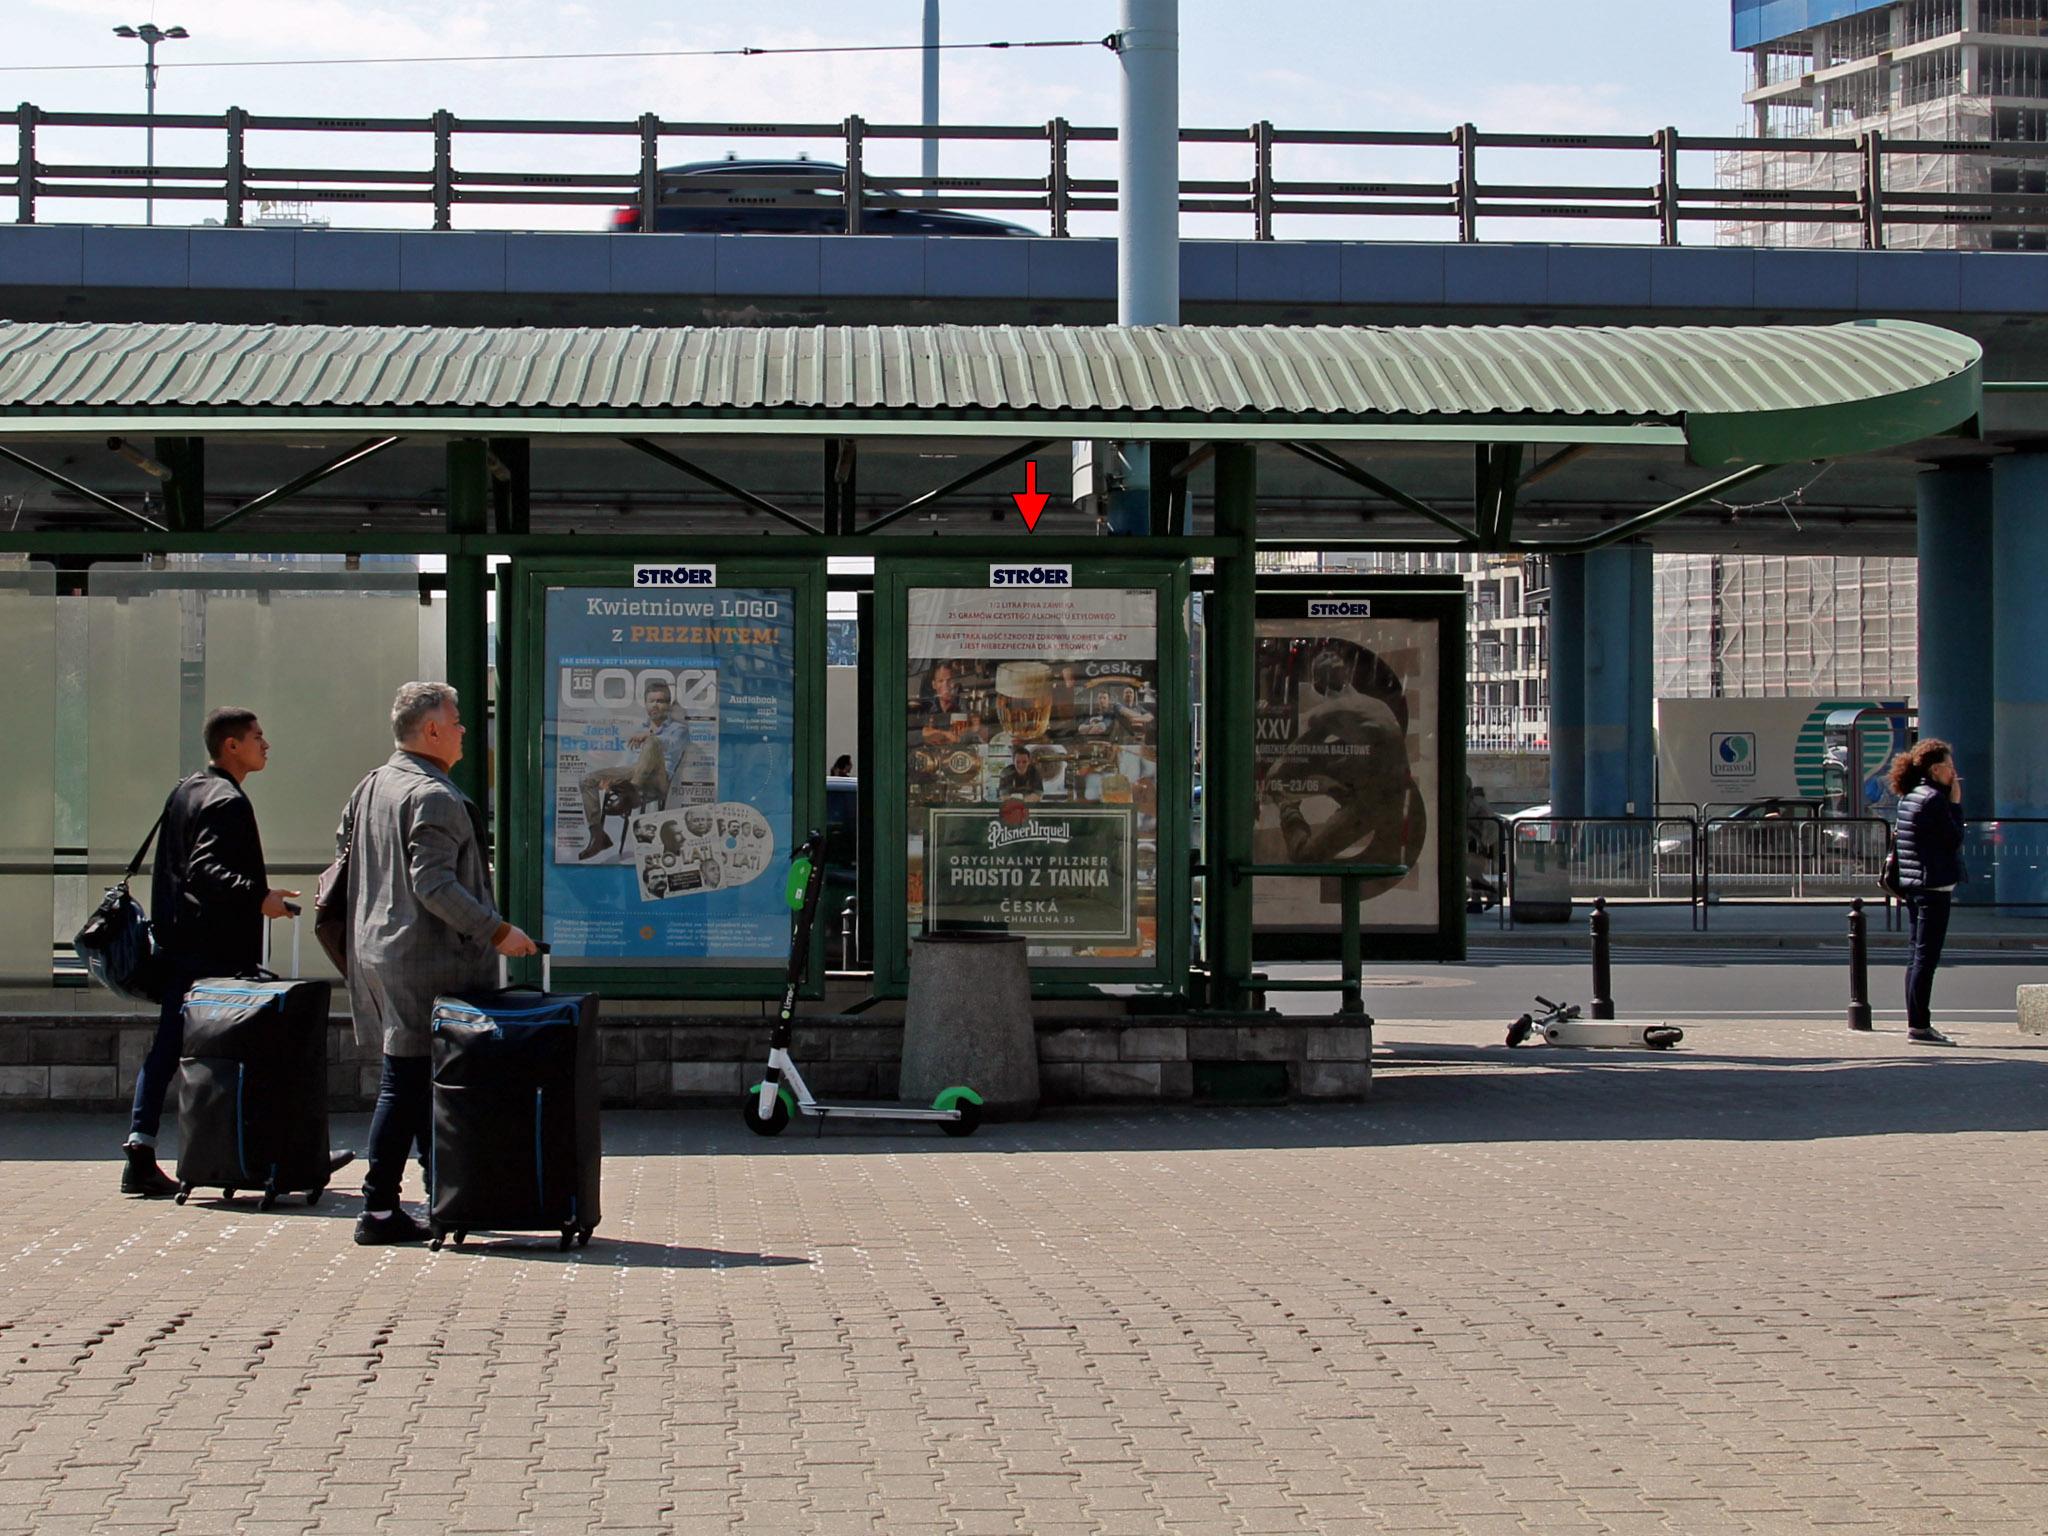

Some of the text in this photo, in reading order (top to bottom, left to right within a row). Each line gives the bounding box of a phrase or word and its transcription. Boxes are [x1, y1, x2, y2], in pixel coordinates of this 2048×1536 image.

[637, 567, 713, 584] STRÖER
[993, 567, 1069, 584] STRÖER
[586, 598, 778, 617] Kwietniowe LOGO
[1310, 602, 1369, 615] STRÖER
[958, 611, 992, 620] GRAMÓW
[993, 612, 1031, 620] CZYSTEGO
[1071, 612, 1116, 620] ETYLOWEGO
[612, 626, 781, 644] z PREZENTEM!
[935, 633, 961, 641] NAWET
[962, 643, 981, 651] JEST
[981, 643, 1036, 651] NIEBEZPIECZNA
[1085, 662, 1143, 677] Česká
[561, 668, 717, 708] LOGO
[573, 676, 593, 691] 16
[728, 695, 778, 705] Audiobook
[1255, 718, 1292, 739] XXV
[988, 820, 1070, 850] Pilsner Urquell
[950, 855, 1109, 866] ORYGINALNY PILZNER
[951, 868, 1110, 887] PROSTO Z TANKA
[1000, 897, 1059, 913] ČESKÁ
[983, 915, 999, 924] UL.
[1004, 915, 1060, 924] CHMIELNA
